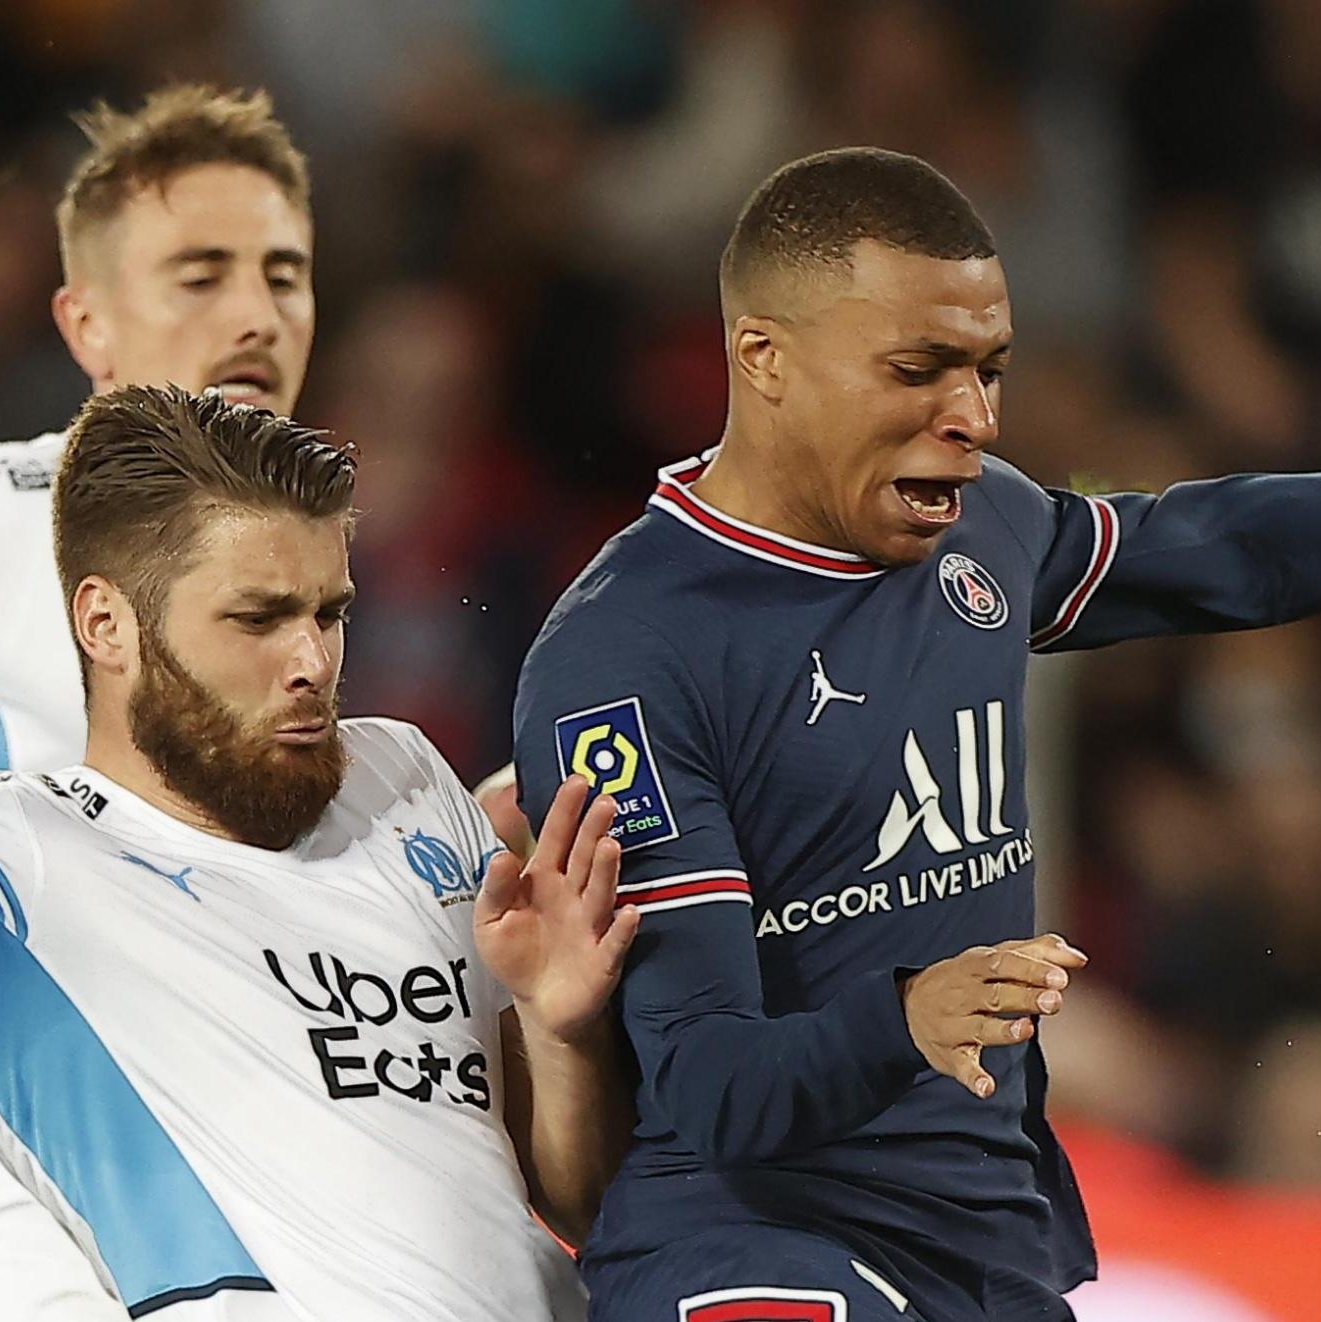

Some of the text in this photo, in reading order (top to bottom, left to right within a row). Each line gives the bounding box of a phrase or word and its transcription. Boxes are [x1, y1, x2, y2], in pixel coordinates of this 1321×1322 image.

[626, 815, 662, 834] Eats
[756, 882, 892, 938] ACCOR
[899, 862, 964, 907] LIVE
[262, 948, 472, 1026] Uber
[307, 1025, 491, 1112] Eats
